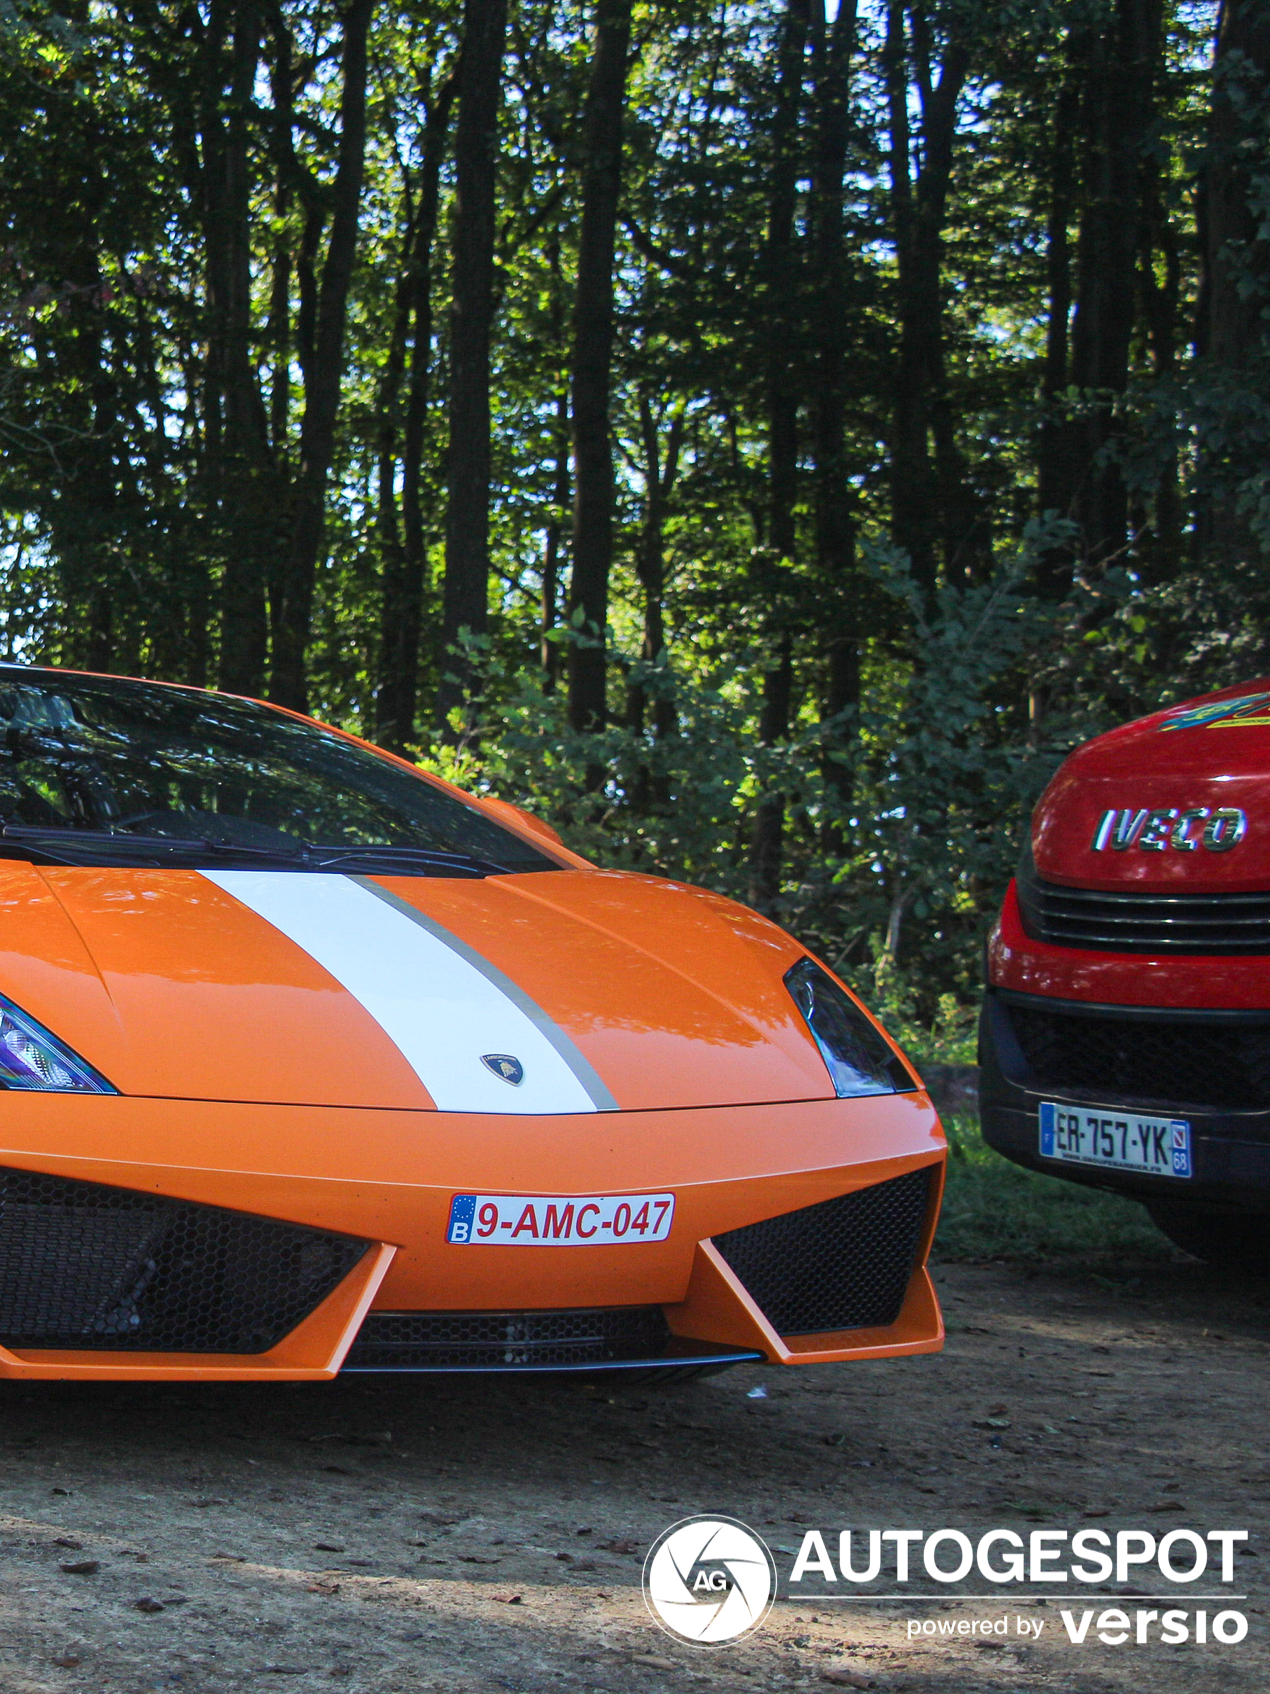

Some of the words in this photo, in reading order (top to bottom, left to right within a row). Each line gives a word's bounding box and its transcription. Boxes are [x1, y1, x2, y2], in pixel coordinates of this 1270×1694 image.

[1091, 808, 1248, 853] IVECO
[1056, 1112, 1168, 1166] ER-757-YK
[450, 1222, 469, 1242] B
[476, 1201, 671, 1239] 9-AMC-047
